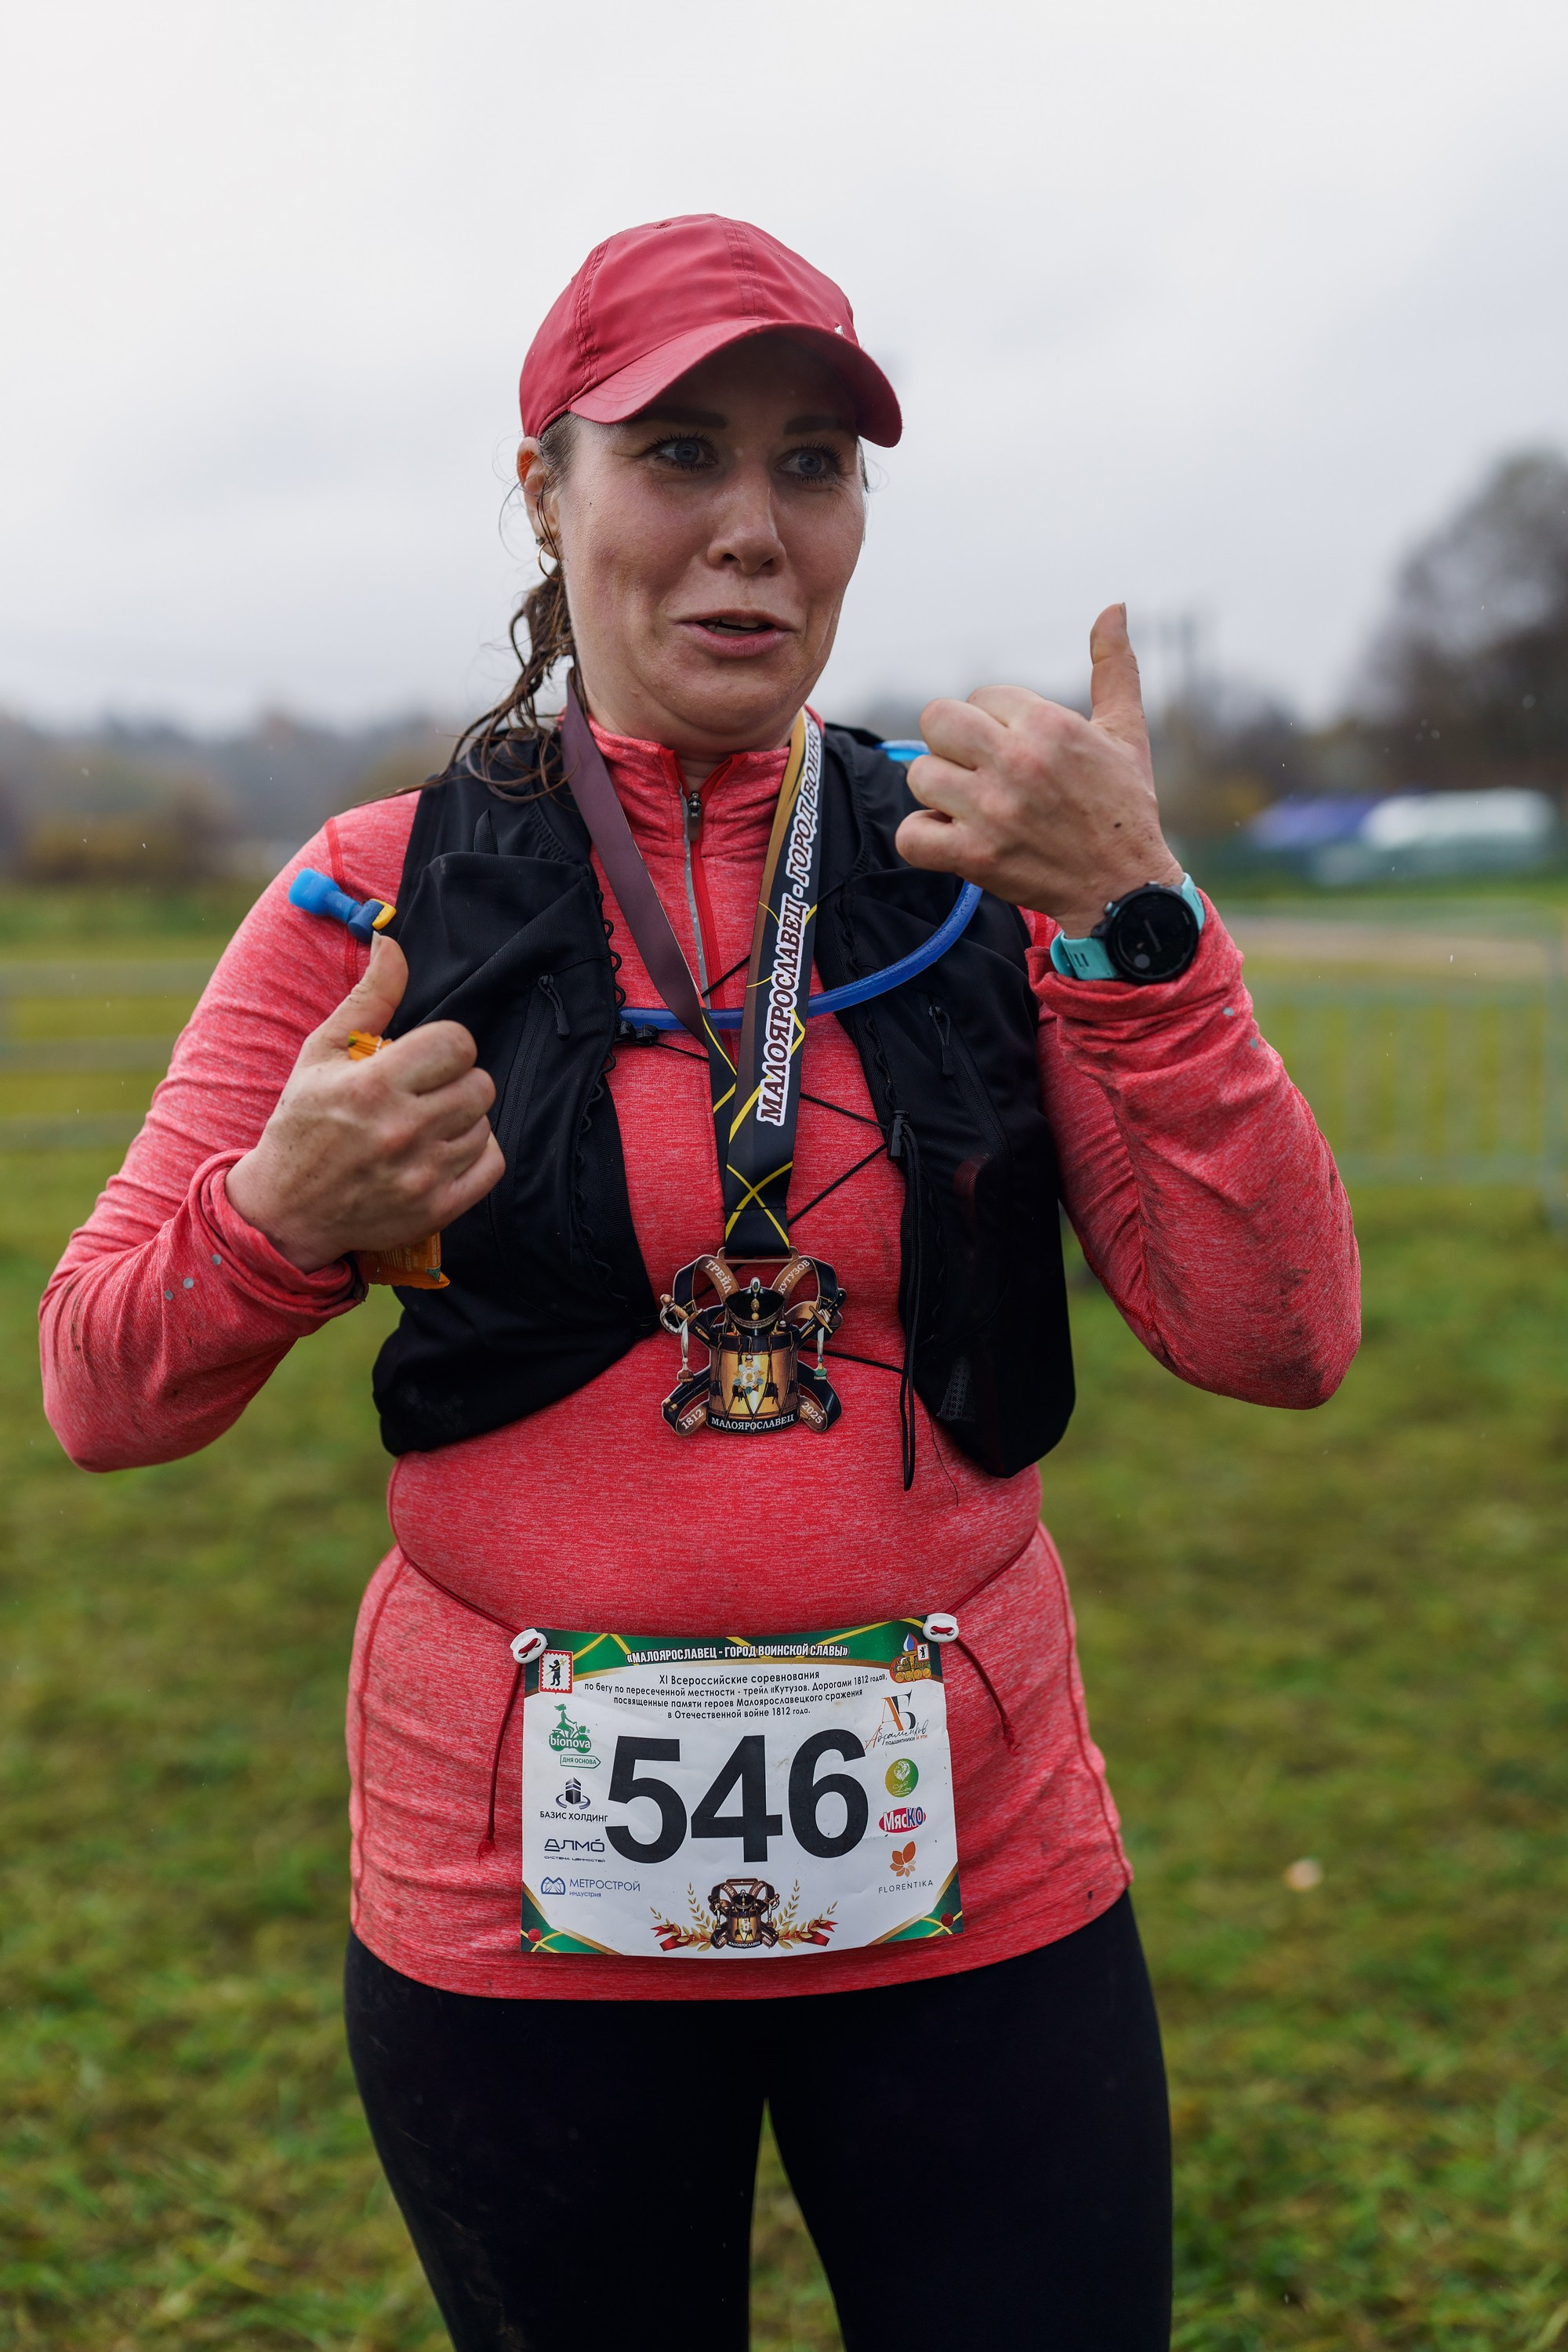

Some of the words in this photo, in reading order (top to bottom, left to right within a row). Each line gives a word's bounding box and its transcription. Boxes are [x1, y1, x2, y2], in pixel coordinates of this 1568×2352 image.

[759, 895, 808, 1123] МАЛОЯРОСЛАВЕЦ
[789, 800, 816, 884] ГОРОД
[705, 1258, 733, 1294] ТРЕЙЛ
[778, 1259, 811, 1295] КУТУЗОВ
[681, 1409, 704, 1430] 1812
[711, 1413, 795, 1431] МАЛОЯРОСЛАВЕЦ
[800, 1401, 824, 1424] 2025
[626, 1646, 717, 1664] «МАЛОЯРОСЛАВЕЦ
[724, 1646, 757, 1658] ГОРОД
[758, 1642, 809, 1657] ВОИНСКОЙ
[810, 1645, 848, 1657] СЛАВЫ»
[596, 1682, 613, 1694] бегу
[626, 1686, 685, 1697] пересеченной
[688, 1688, 735, 1697] местности
[743, 1686, 768, 1697] трейл
[770, 1685, 810, 1696] «Кутузов.
[811, 1679, 852, 1692] Дорогами
[854, 1675, 869, 1686] 1812
[869, 1673, 887, 1683] года»,
[659, 1675, 668, 1684] XI
[671, 1674, 748, 1686] Всероссийские
[750, 1671, 820, 1685] соревнования
[614, 1696, 669, 1708] посвященные
[671, 1700, 702, 1708] памяти
[704, 1700, 734, 1710] героев
[736, 1694, 822, 1708] Малоярославецкого
[825, 1688, 863, 1702] сражения
[674, 1709, 742, 1719] Отечественной
[744, 1707, 769, 1718] войне
[772, 1707, 790, 1716] 1812
[550, 1735, 591, 1748] bionova
[885, 1736, 916, 1746] ПОДШИПНИКИ
[604, 1729, 869, 1864] 546
[539, 1810, 567, 1820] БАЗИС
[568, 1812, 608, 1823] ХОЛДИНГ
[569, 1878, 641, 1892] МЕТРОСТРОЙ
[878, 1879, 934, 1894] FLORENTIKA
